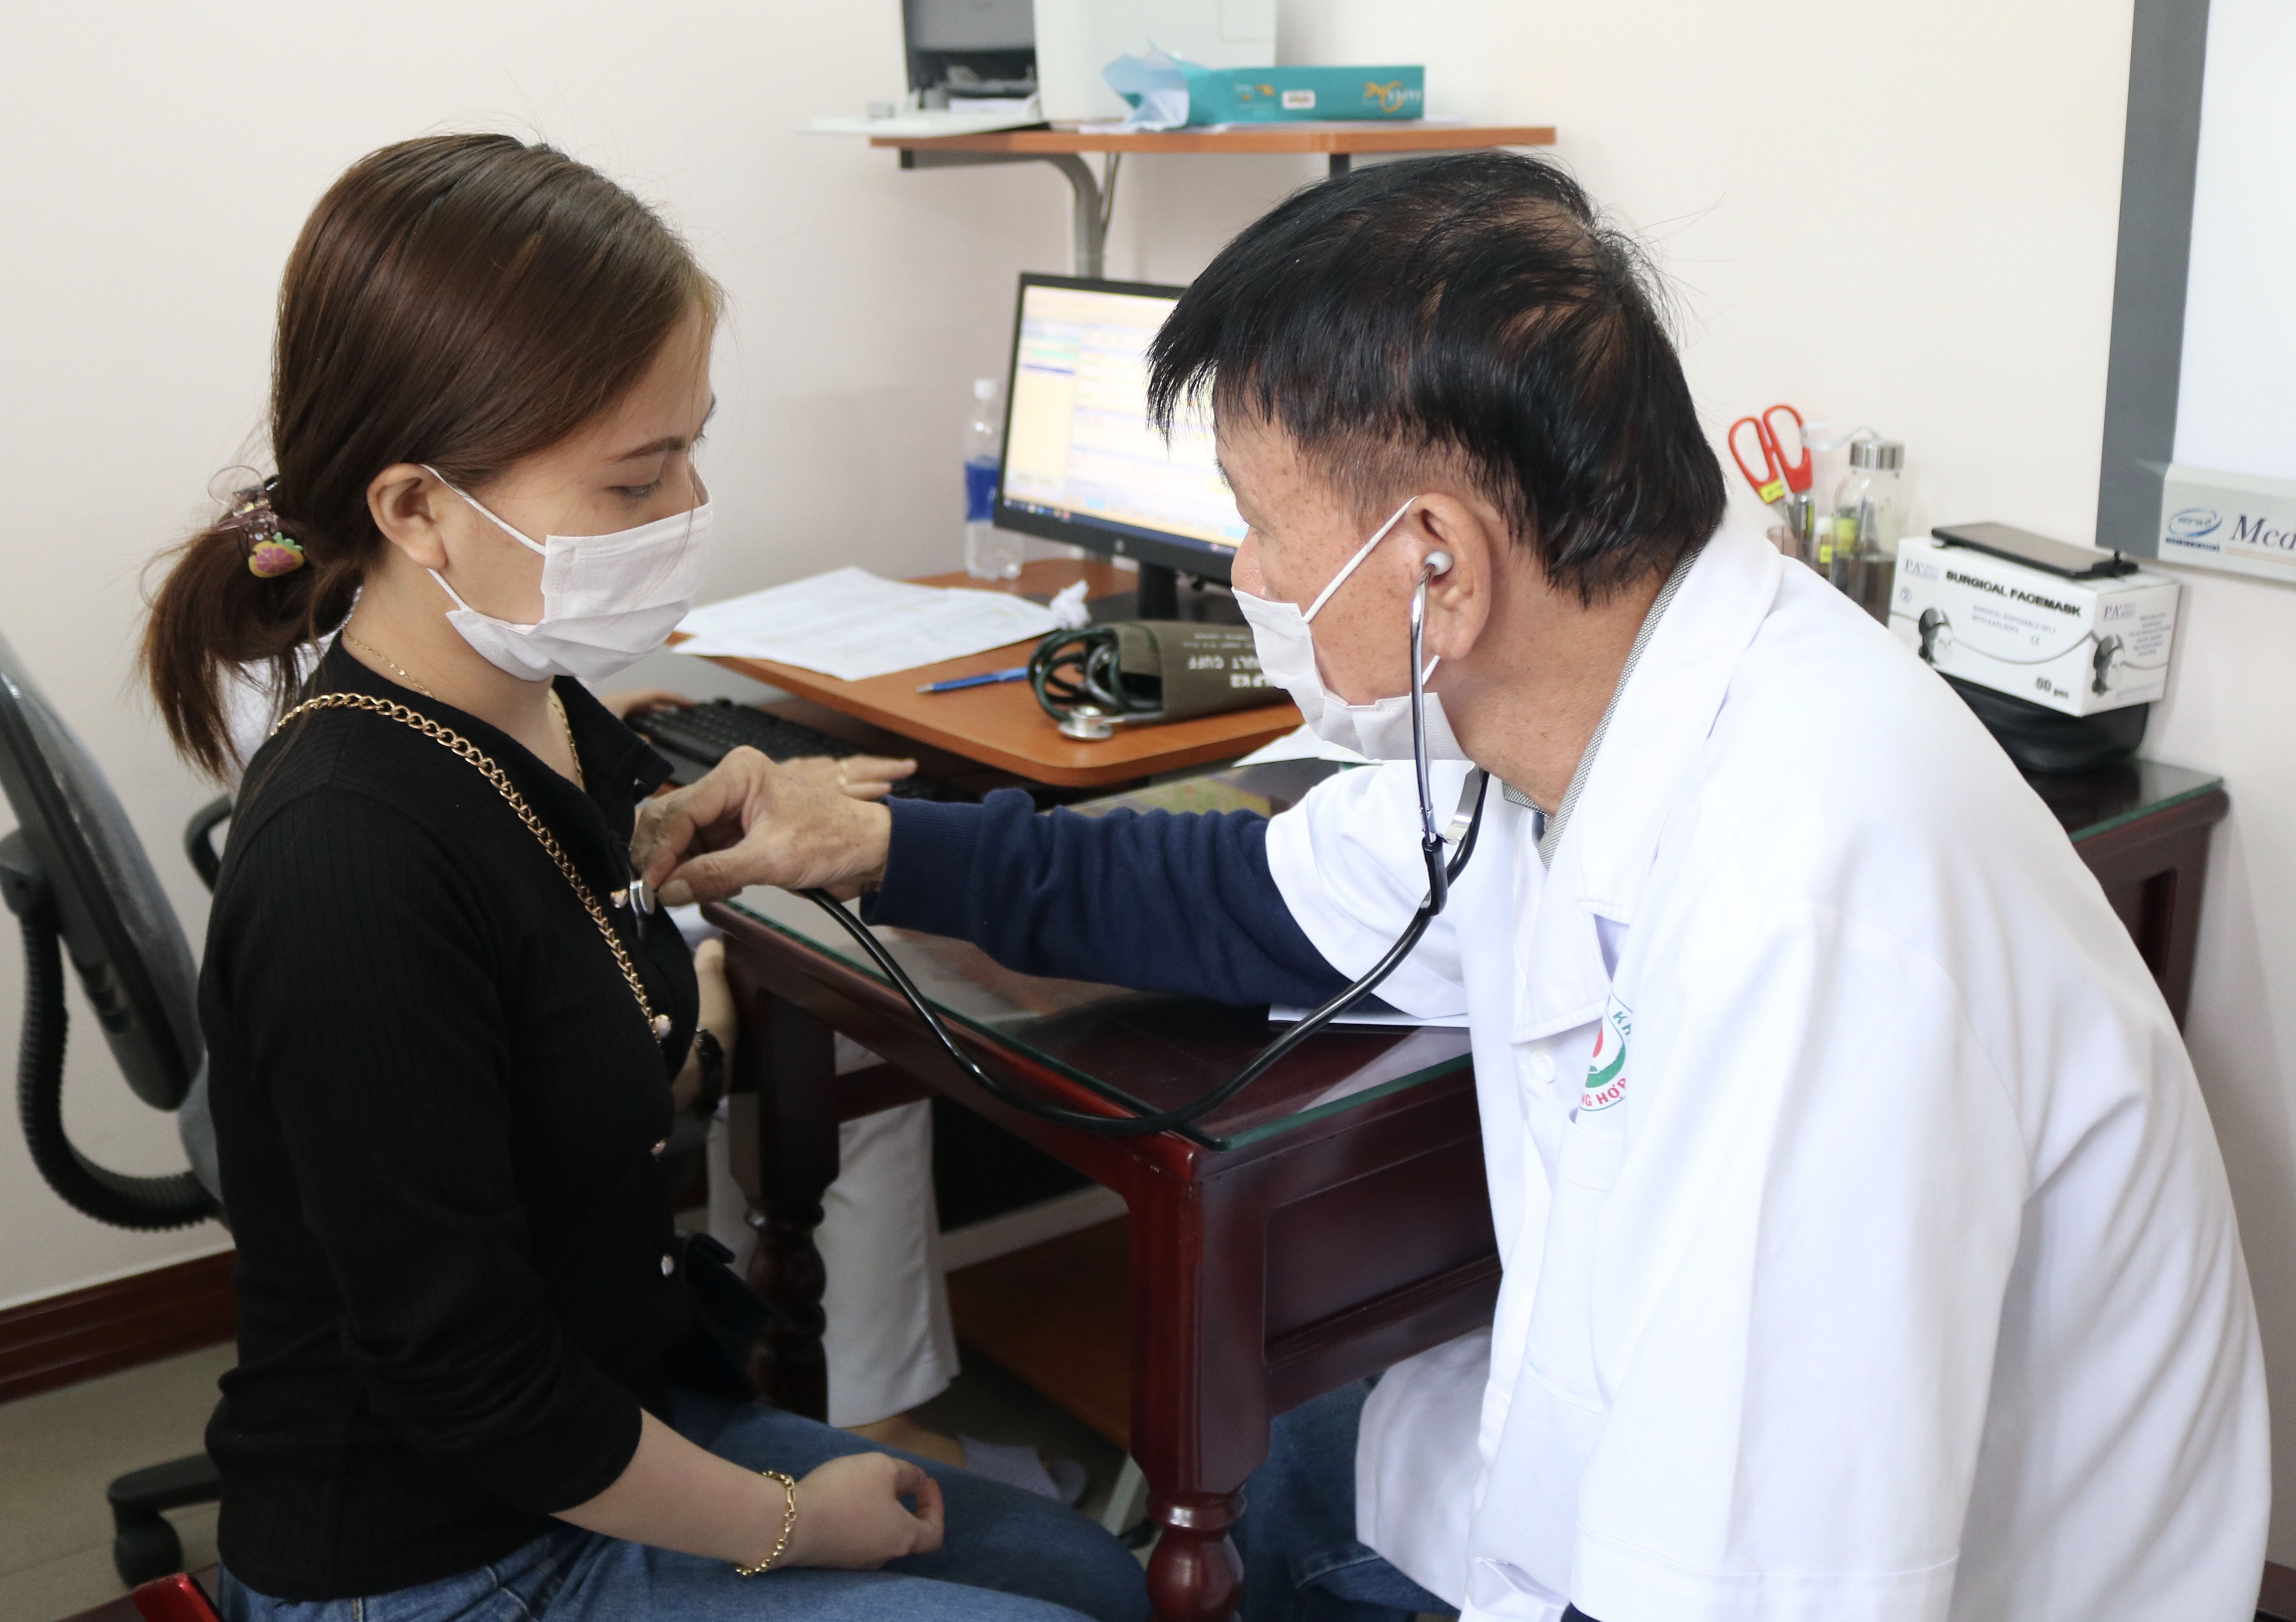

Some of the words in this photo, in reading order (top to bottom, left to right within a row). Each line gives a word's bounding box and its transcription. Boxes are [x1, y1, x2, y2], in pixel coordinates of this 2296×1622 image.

[1946, 570, 2007, 597] SURGICAL
[2010, 588, 2082, 617] FACEMASK
[1188, 654, 1225, 670] CUFF
[2036, 677, 2052, 692] 50
